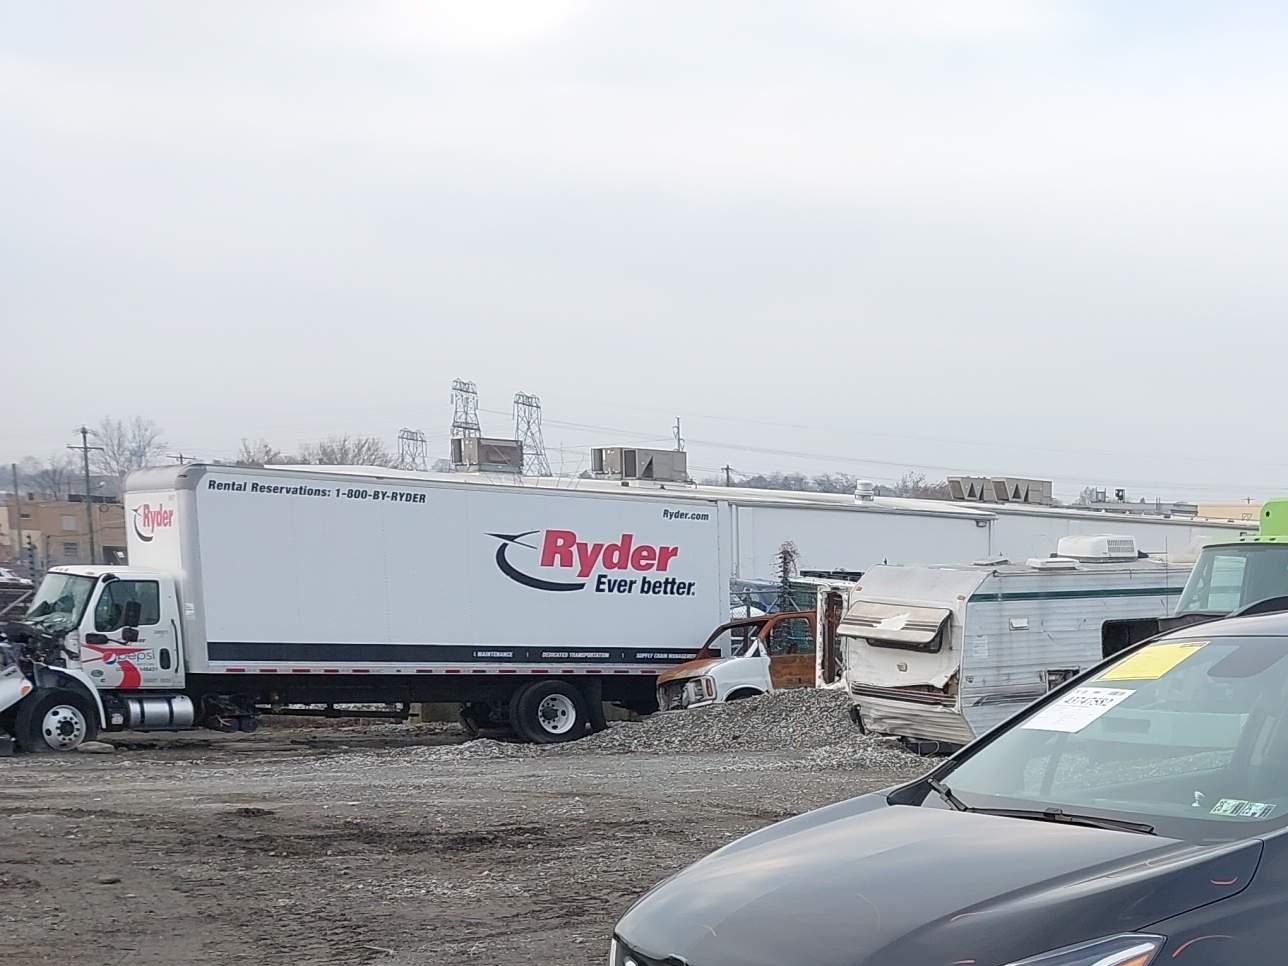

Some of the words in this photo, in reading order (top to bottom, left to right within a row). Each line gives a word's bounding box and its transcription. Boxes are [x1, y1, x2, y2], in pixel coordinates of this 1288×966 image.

[208, 480, 247, 492] Rental
[251, 482, 331, 498] Reservations:
[335, 488, 427, 504] 1-800-BY-RYDER
[143, 503, 174, 534] Ryder
[663, 509, 709, 521] Ryder.com
[540, 529, 679, 578] Ryder
[595, 574, 637, 594] Ever
